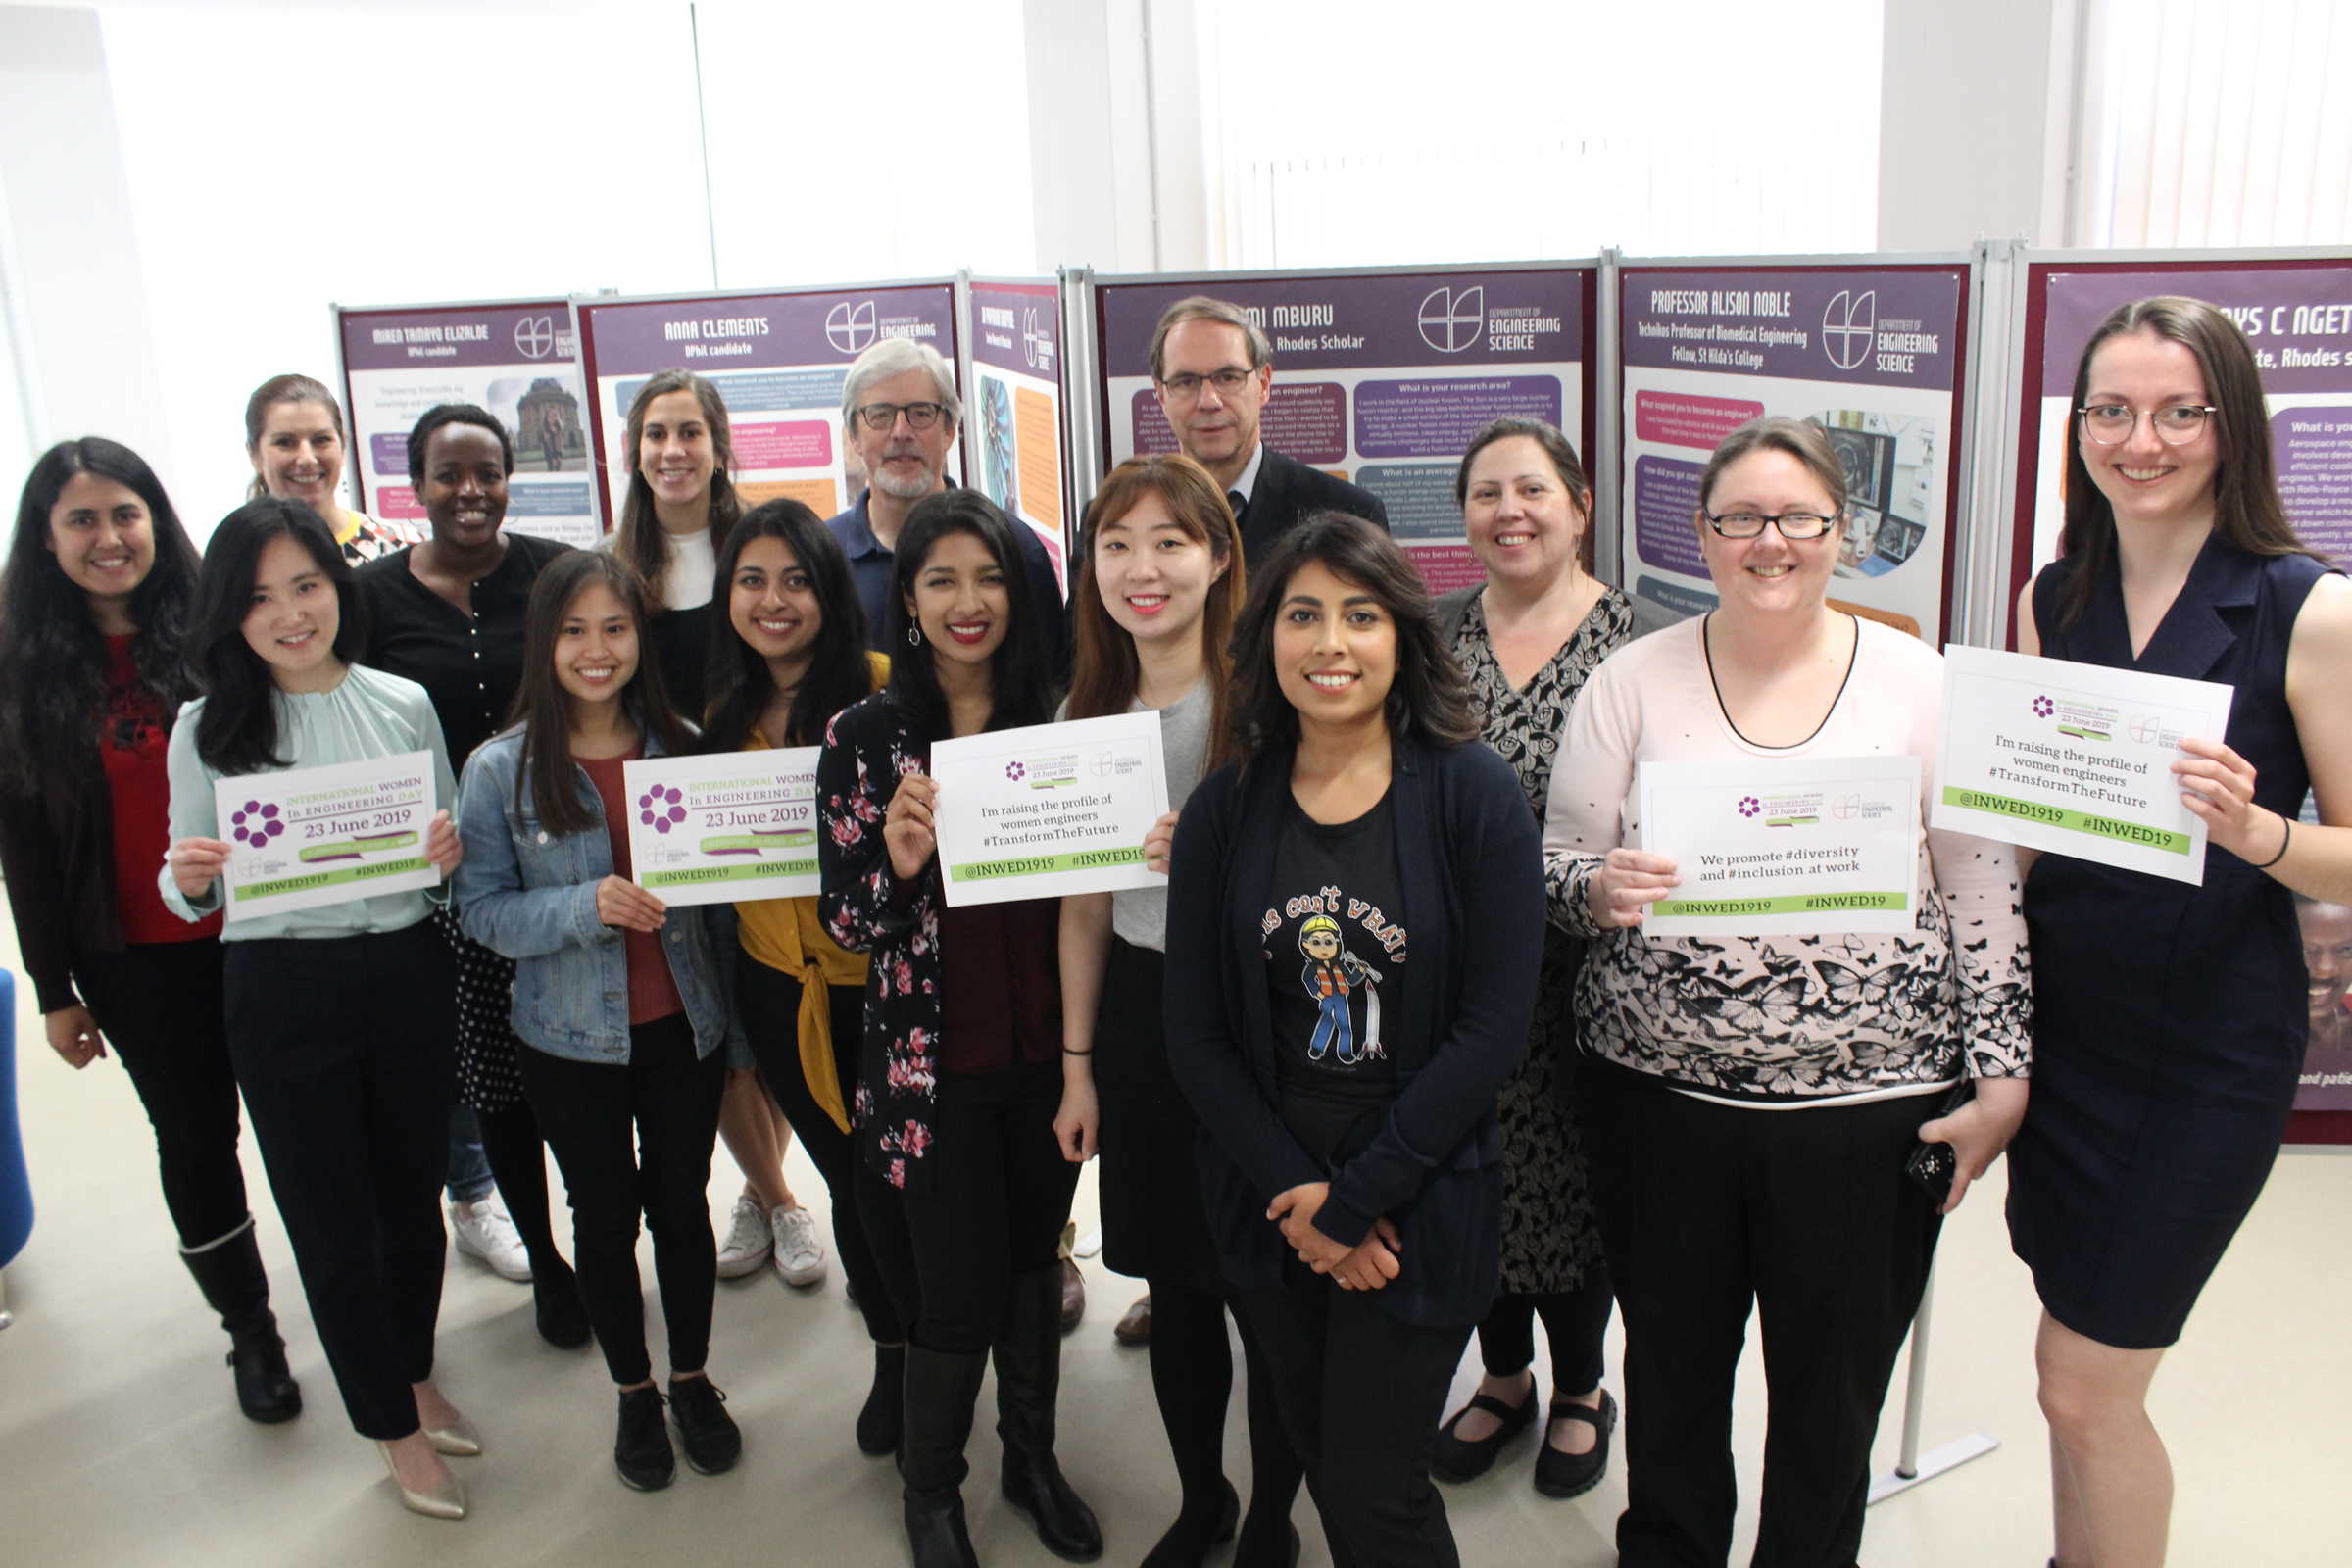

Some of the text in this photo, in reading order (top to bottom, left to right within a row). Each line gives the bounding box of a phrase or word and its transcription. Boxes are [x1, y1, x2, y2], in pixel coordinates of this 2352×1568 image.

[1489, 308, 1541, 318] DEPARTMENT OF
[1651, 290, 1791, 317] PROFESSOR ALISON NOBLE
[1246, 304, 1333, 328] MI MBURU
[1489, 318, 1561, 334] ENGINEERING
[1878, 319, 1913, 330] DEPARTMENT
[2270, 306, 2287, 335] C
[665, 318, 768, 341] ANNA CLEMENTS
[880, 323, 936, 338] ENGINEERING
[1639, 321, 1807, 349] Technikos Professor of Biomedical Engineering
[425, 346, 457, 357] candidate
[685, 343, 753, 358] DPhil candidate
[1277, 335, 1364, 353] Rhodes Scholar
[1489, 334, 1535, 351] SCIENCE
[1878, 332, 1938, 354] ENGINEERING
[1672, 346, 1764, 370] Fellow, St Hilda's College
[1876, 354, 1914, 373] SCIENCE
[2281, 348, 2340, 368] Rhodes
[1283, 386, 1323, 397] engineer?
[1431, 384, 1449, 393] your
[1450, 381, 1487, 391] research
[1489, 380, 1511, 390] area?
[2291, 423, 2321, 432] What
[2324, 423, 2334, 432] is
[1994, 735, 2148, 775] I'm raising the profile of
[2013, 757, 2127, 787] women engineers
[286, 777, 422, 805] INTERNATIONAL WOMEN
[690, 774, 816, 792] INTERNATIONAL WOMEN
[1989, 767, 2147, 808] #TransformTheFuture
[288, 790, 423, 818] In ENGINEERING DAY
[707, 789, 790, 804] ENGINEERING
[981, 793, 1113, 817] I'm raising the profile of
[306, 810, 412, 838] 23 June 2019
[706, 807, 808, 827] 23 June 2019
[1001, 811, 1099, 831] women engineers
[1959, 792, 2172, 846] @INWED1919 #INWED19
[984, 824, 1119, 847] #TransformTheFuture
[965, 849, 1146, 878] @INWED1919 #INWED19
[1701, 846, 1859, 866] We promote #diversity
[251, 859, 416, 896] @INWED1919 #INWED19
[655, 861, 815, 882] @INWED1919 #INWED19
[1699, 860, 1860, 882] and #inclusion at work
[1672, 896, 1886, 914] @INWED1919 #INWED19
[2299, 1072, 2319, 1085] and
